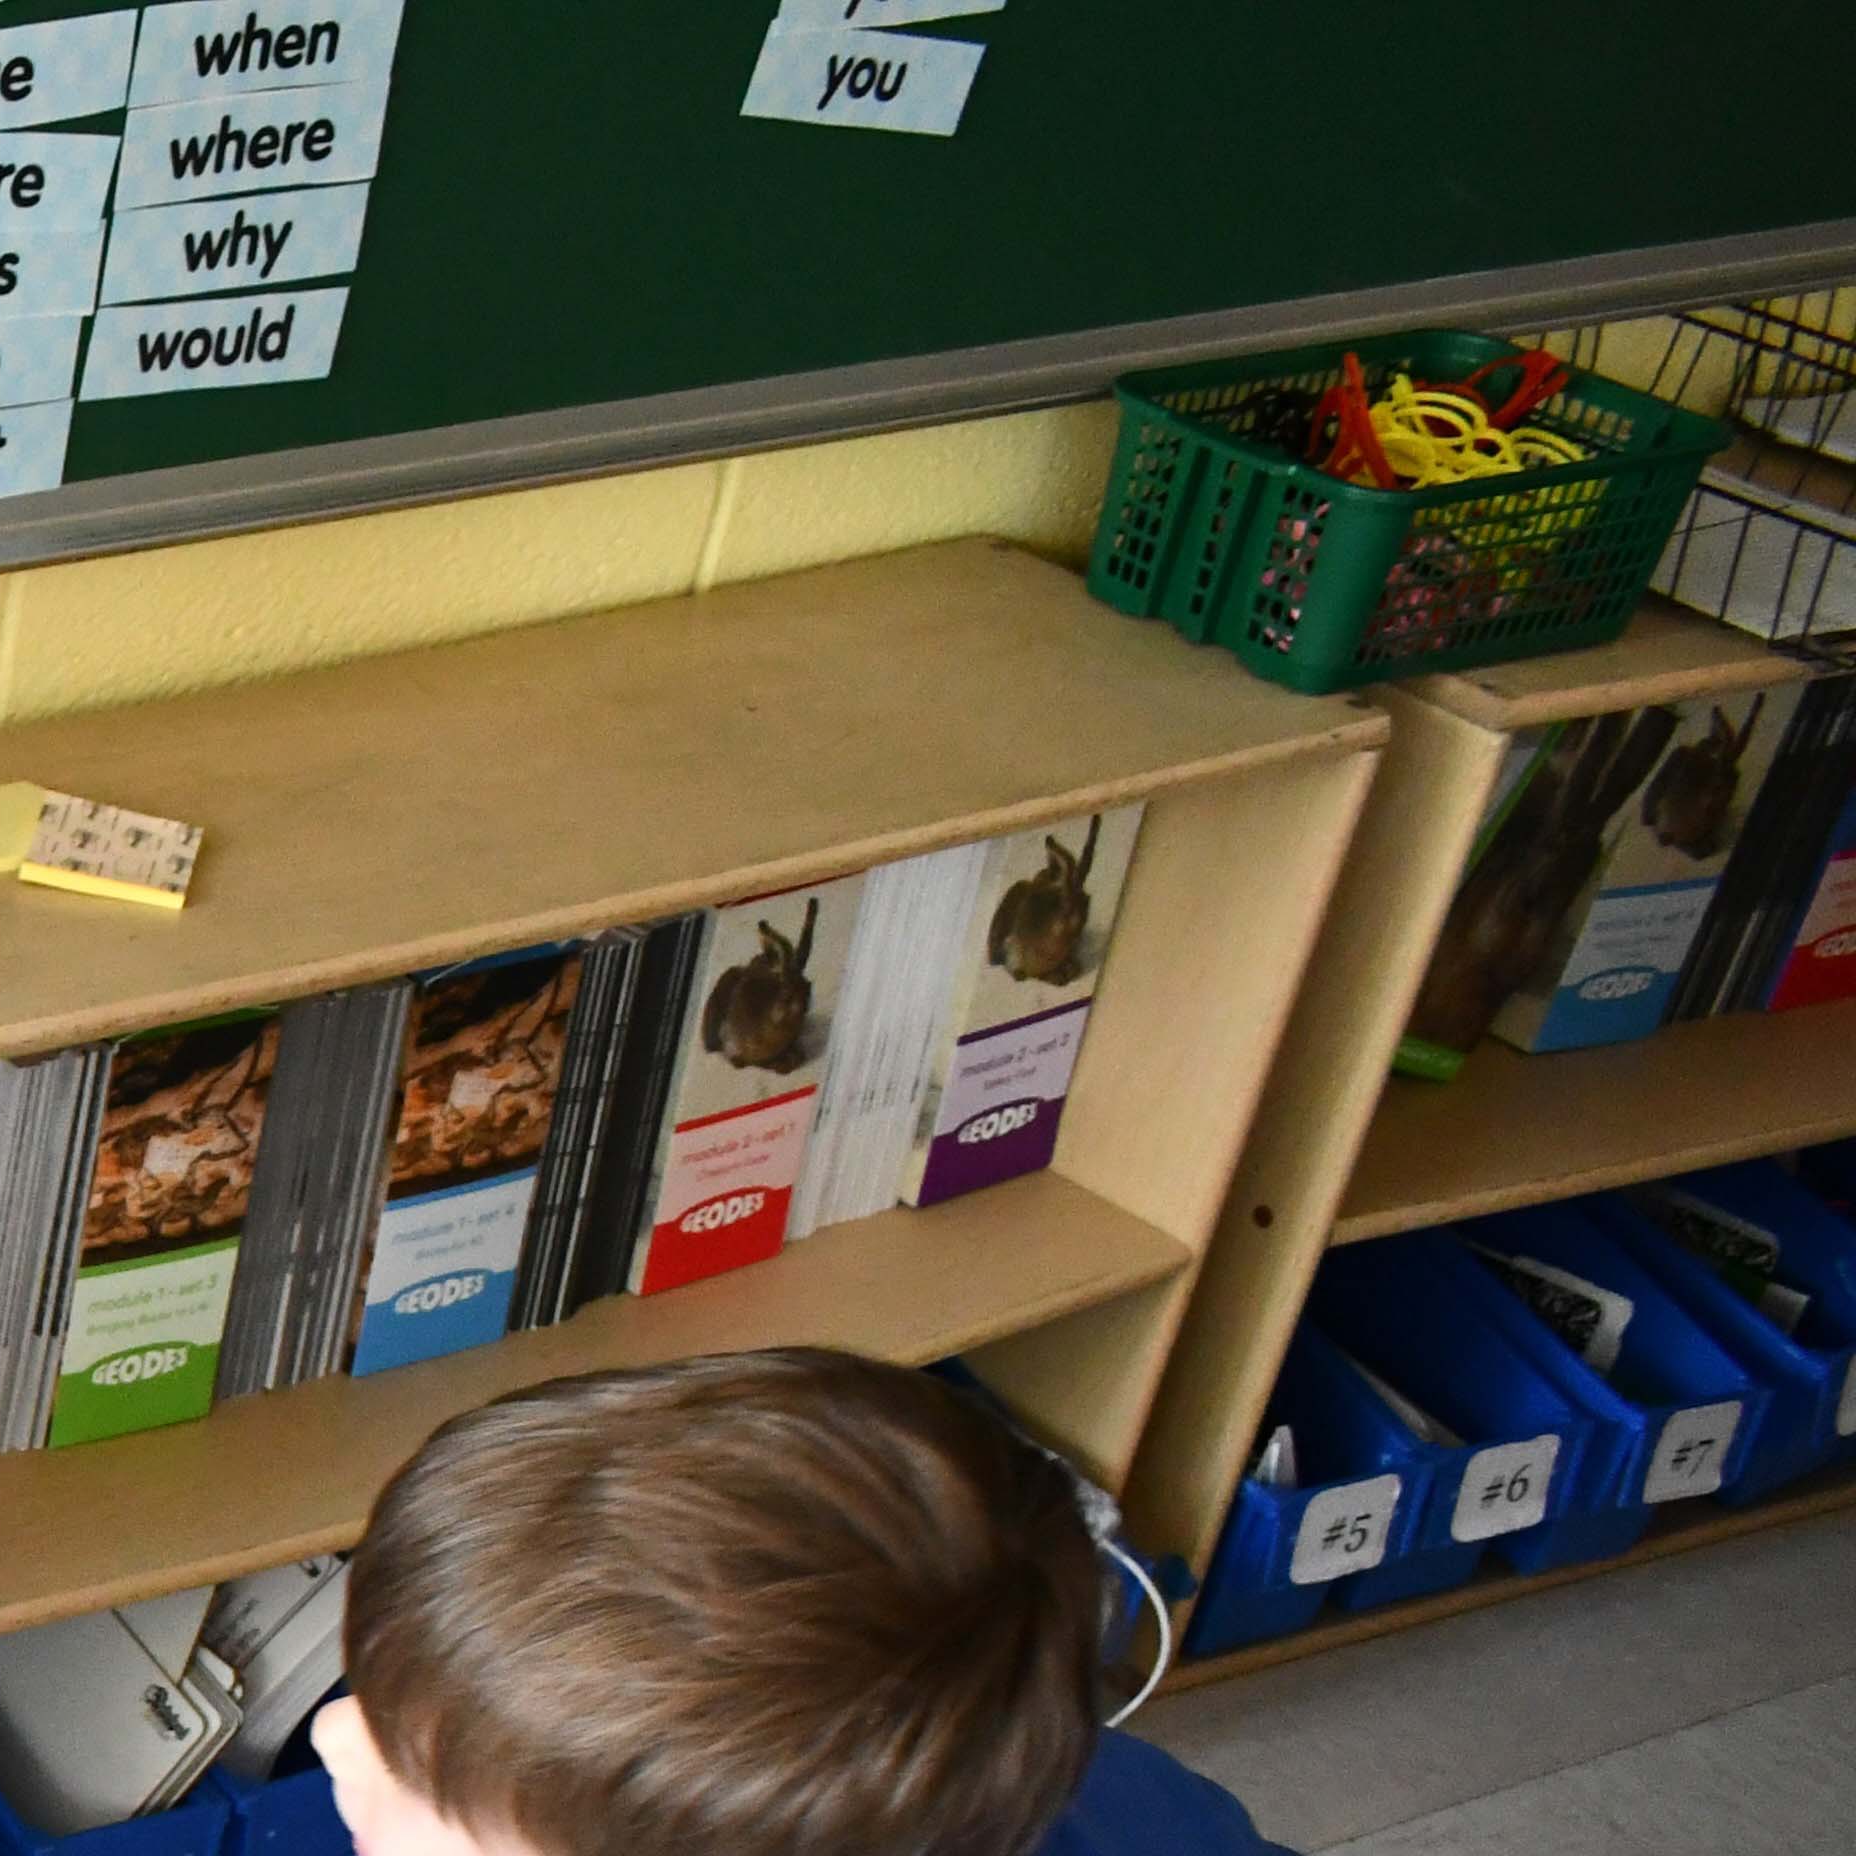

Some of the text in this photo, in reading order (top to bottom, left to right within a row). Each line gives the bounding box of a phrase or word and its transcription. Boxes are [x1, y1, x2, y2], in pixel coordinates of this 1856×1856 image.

[195, 12, 339, 77] when
[818, 55, 907, 110] you
[171, 115, 334, 179] where
[185, 210, 292, 278] why
[137, 304, 295, 372] would
[92, 1346, 188, 1386] GEODES
[1671, 1438, 1714, 1478] #7
[1479, 1462, 1533, 1510] #6
[1322, 1513, 1372, 1553] #5
